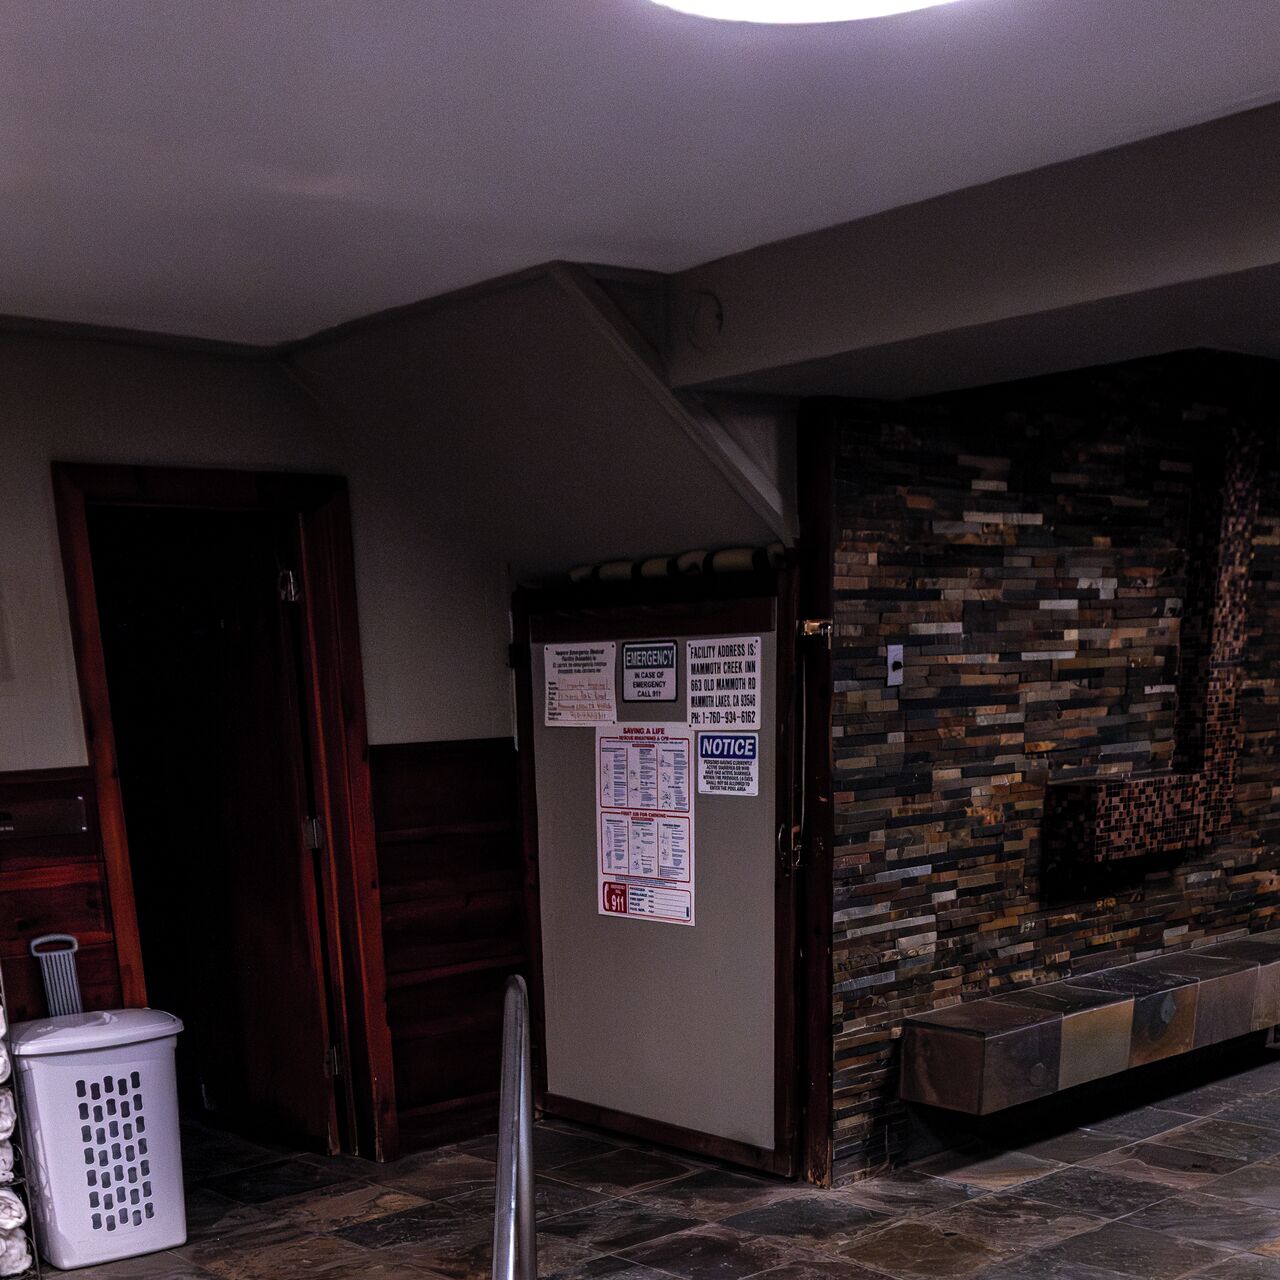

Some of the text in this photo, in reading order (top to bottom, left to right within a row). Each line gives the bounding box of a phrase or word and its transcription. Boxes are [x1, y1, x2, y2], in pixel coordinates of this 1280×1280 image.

[626, 649, 673, 666] EMERGENCY
[690, 643, 756, 659] FACILITY ADDRESS IS:
[641, 671, 655, 679] CASE
[691, 660, 756, 675] MAMMOTH CREEK INN
[633, 680, 666, 688] EMERGENCY
[690, 676, 756, 692] 663 OLD MAMMOTH RD
[691, 695, 714, 708] MAMMOTH
[733, 694, 739, 707] CA
[691, 710, 756, 724] PH: 1-760-934-6162
[623, 727, 665, 735] SAVING A LIFE
[702, 738, 754, 756] NOTICE
[611, 894, 624, 911] 911
